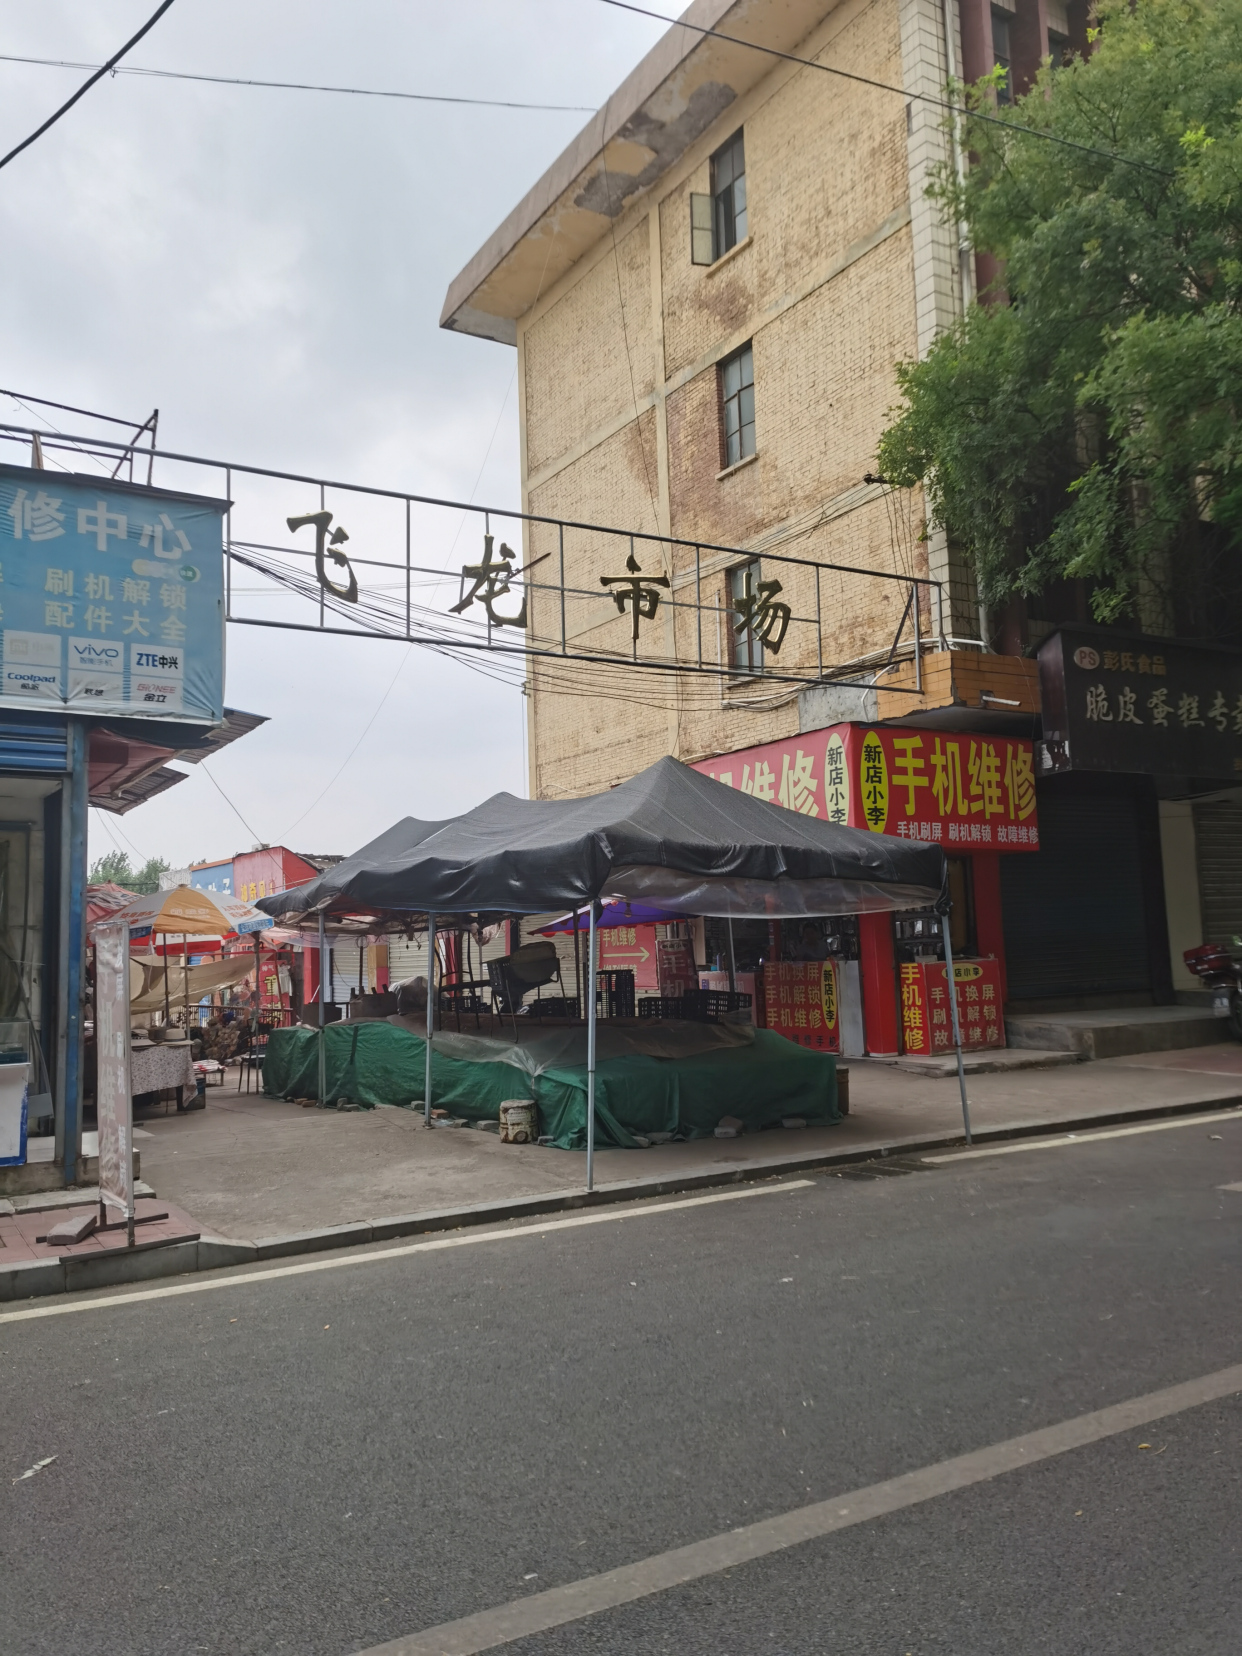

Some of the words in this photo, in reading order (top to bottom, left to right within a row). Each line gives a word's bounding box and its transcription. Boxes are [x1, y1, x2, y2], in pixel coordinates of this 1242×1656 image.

[7, 488, 192, 560] 修中心
[44, 567, 188, 611] 刷机解锁
[286, 509, 792, 655] 飞龙市场
[44, 600, 188, 643] 配件大全
[74, 644, 119, 658] vivo
[1078, 650, 1097, 666] PS
[1103, 650, 1167, 676] 彭氏食品
[7, 672, 56, 683] Coolpad
[136, 683, 177, 694] GIONEE
[143, 693, 168, 703] 金立
[826, 745, 847, 826] 新店小李
[863, 744, 886, 826] 新店小李
[892, 735, 1037, 821] 手机维修
[896, 821, 943, 841] 手机刷屏
[948, 822, 992, 842] 刷机解锁
[997, 825, 1039, 845] 故障维修
[602, 927, 637, 947] 手机维修
[765, 962, 820, 982] 手机换屏
[766, 985, 821, 1005] 手机解锁
[822, 969, 836, 1024] 新店小李
[900, 962, 924, 1050] 手机维修
[766, 1007, 823, 1029] 手机维修
